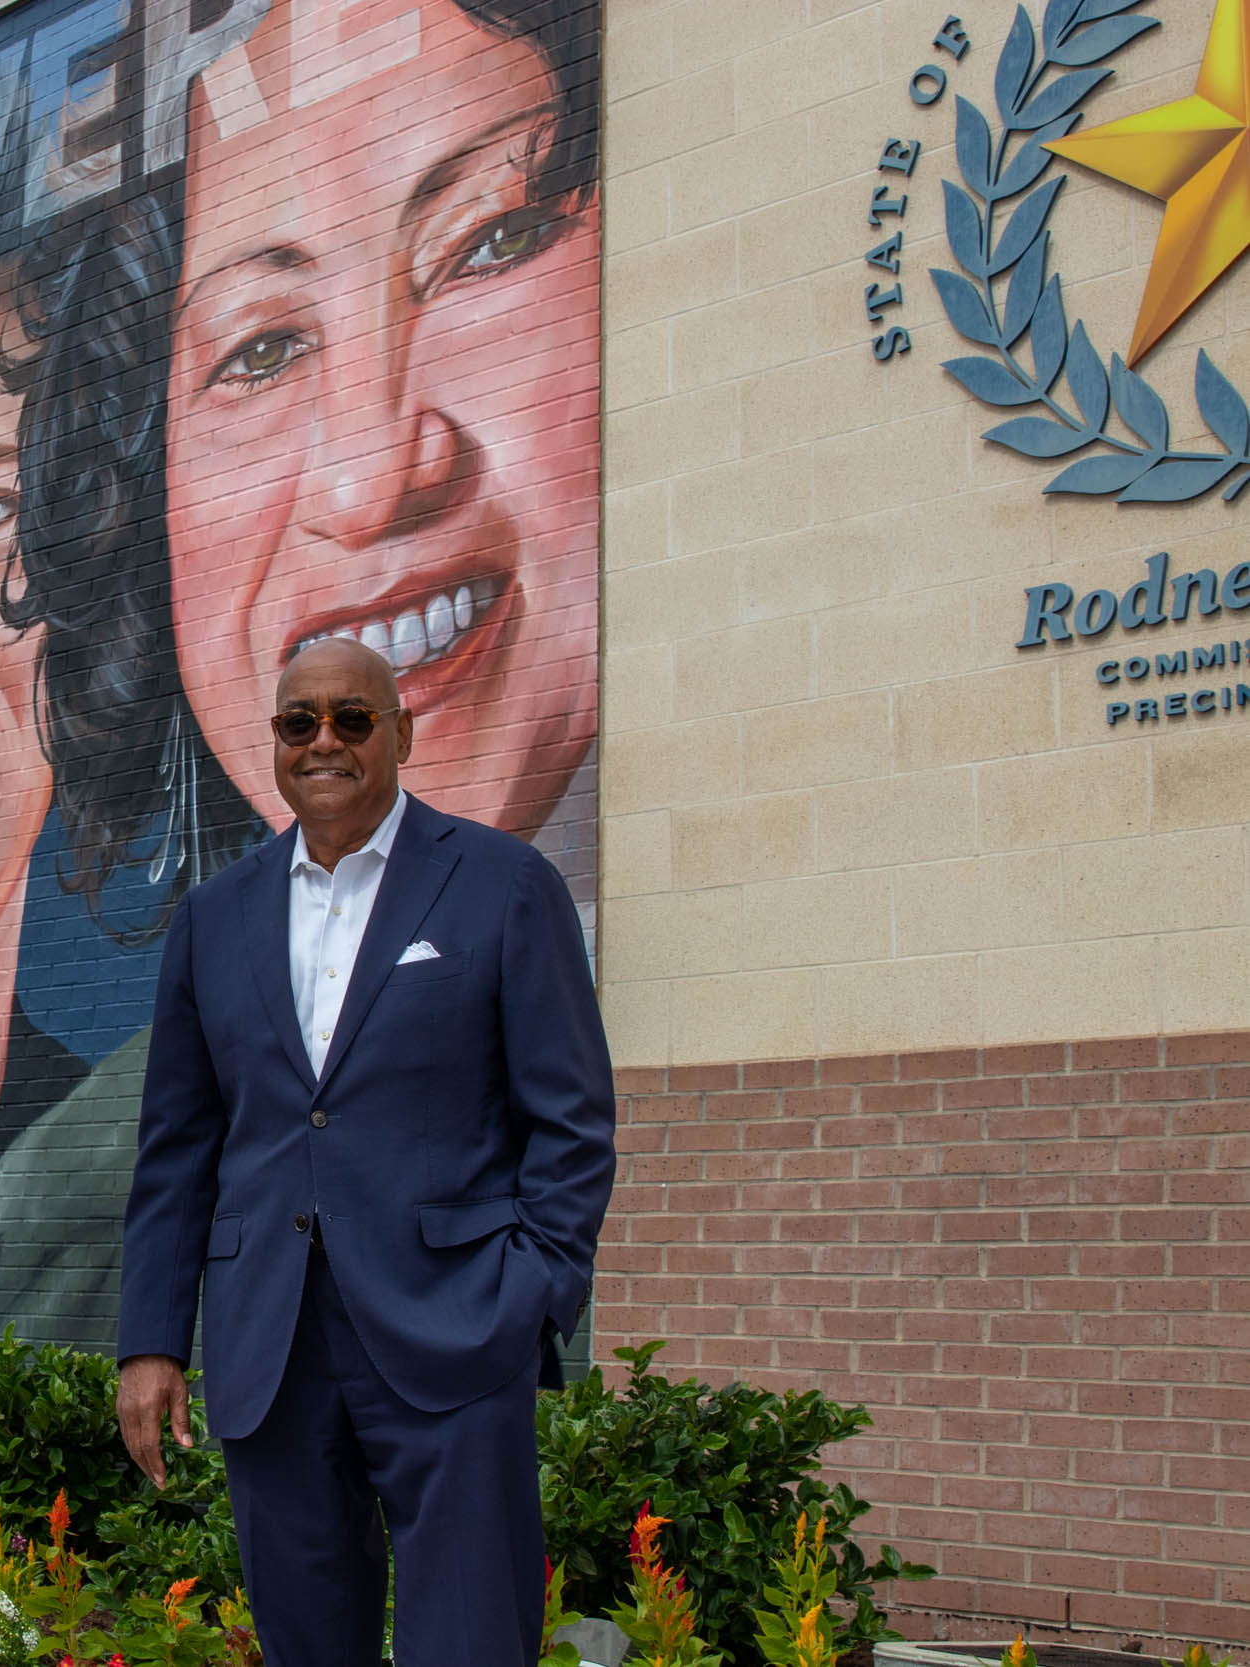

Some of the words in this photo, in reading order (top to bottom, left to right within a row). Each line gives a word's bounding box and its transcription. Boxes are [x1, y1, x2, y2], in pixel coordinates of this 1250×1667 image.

[864, 137, 921, 362] STATE
[909, 14, 971, 106] OF
[1014, 552, 1250, 648] Rodne
[1096, 638, 1250, 683] COMMI
